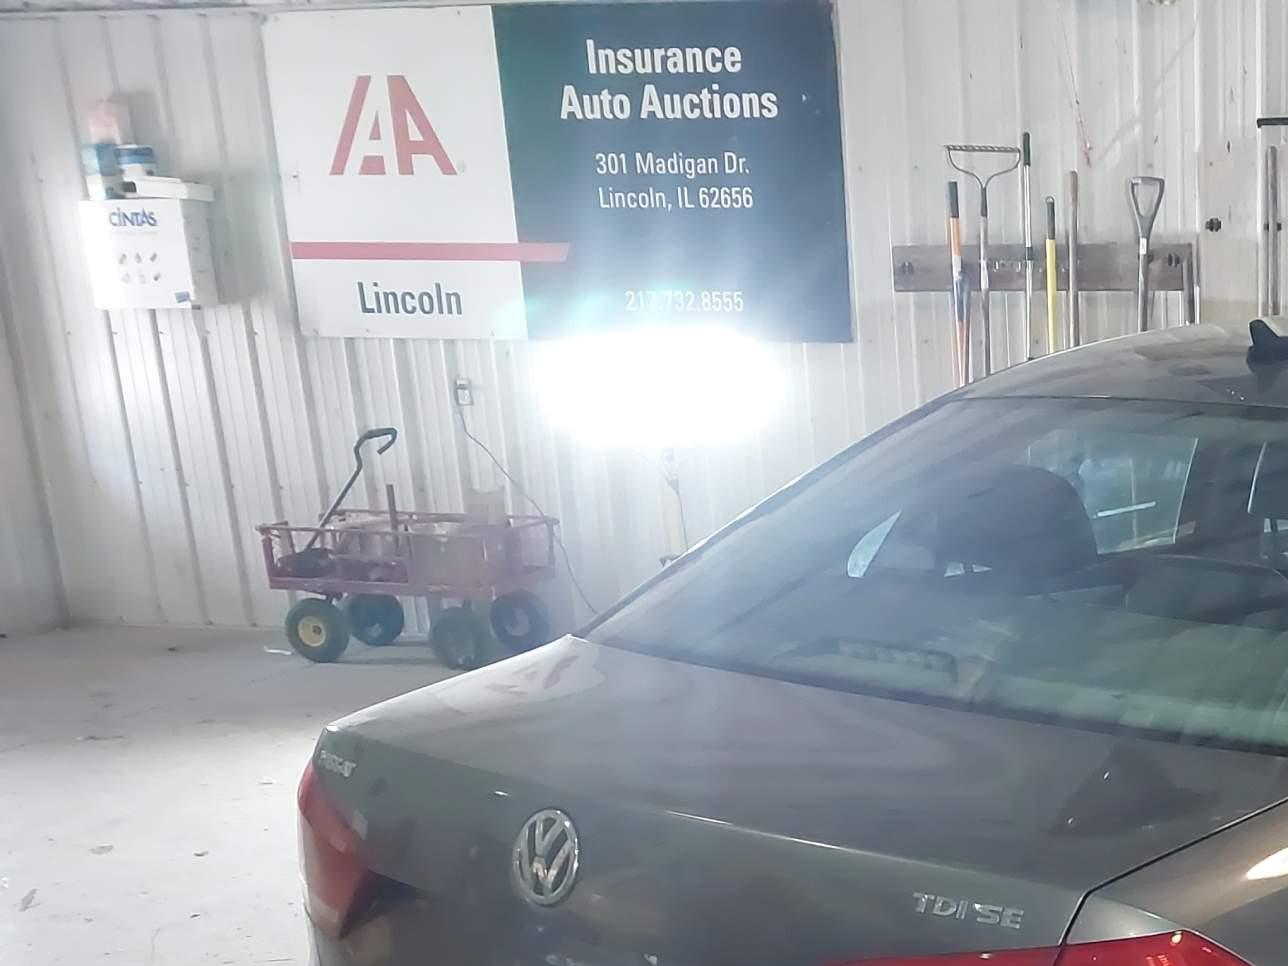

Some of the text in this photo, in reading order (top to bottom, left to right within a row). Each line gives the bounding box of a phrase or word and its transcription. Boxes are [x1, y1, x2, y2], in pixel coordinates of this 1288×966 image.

[586, 39, 742, 74] Insurance
[560, 83, 778, 120] Auto Auctions
[595, 152, 750, 179] 301 Madigan Dr.
[598, 186, 753, 212] Lincoln, IL 62656
[357, 281, 462, 315] Lincoln
[624, 290, 744, 313] 217.732.8555
[912, 891, 1024, 929] TDI SE
